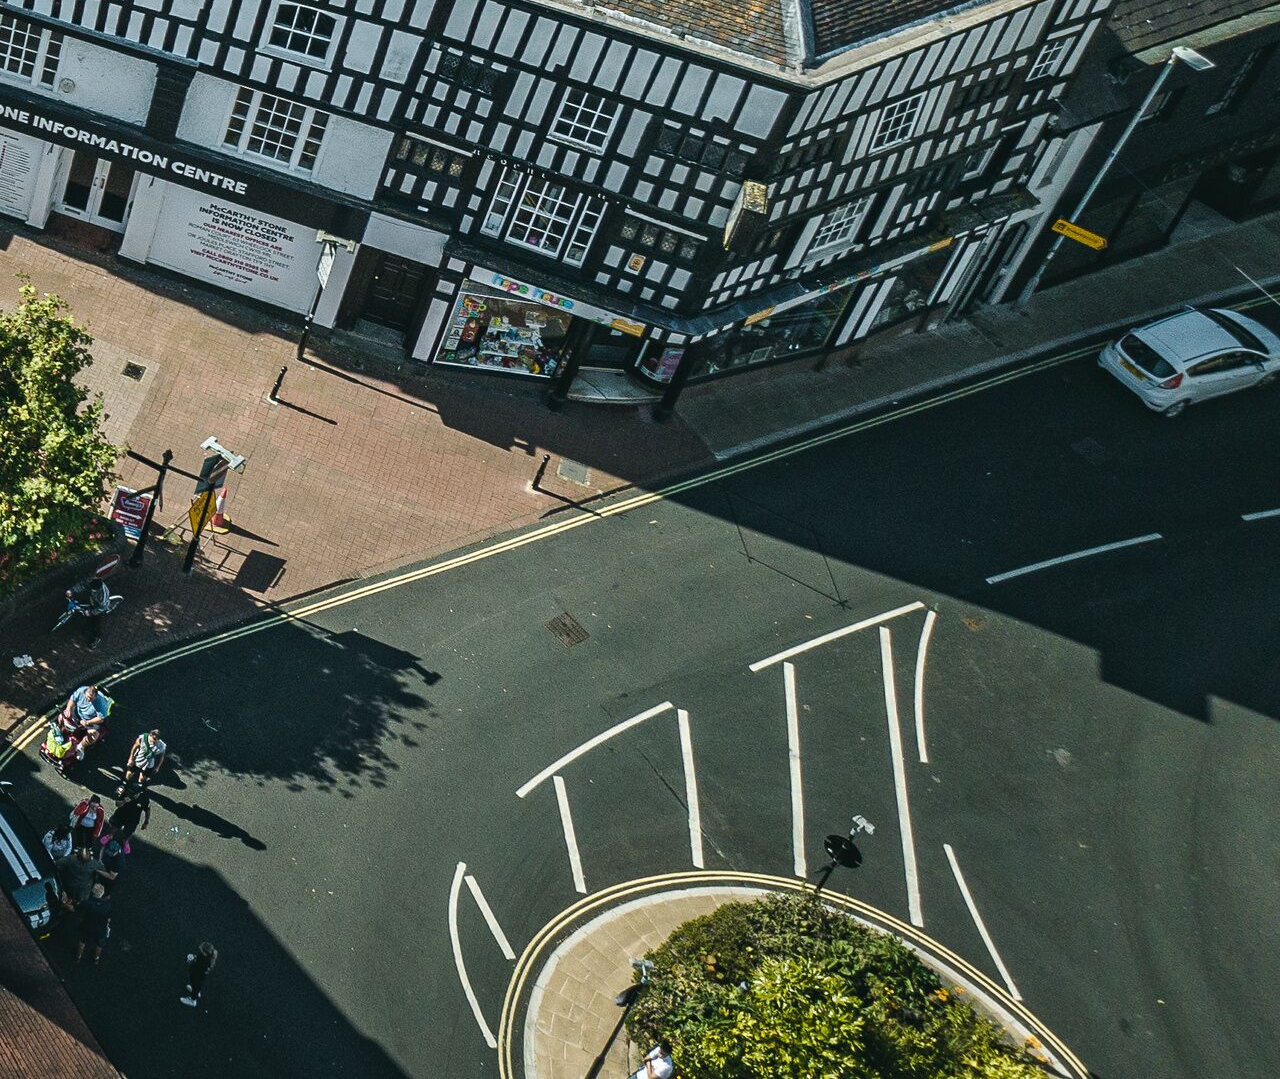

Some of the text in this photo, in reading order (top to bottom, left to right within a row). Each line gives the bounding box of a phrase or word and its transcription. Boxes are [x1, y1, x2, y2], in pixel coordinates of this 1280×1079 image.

[32, 115, 169, 169] INFORMATION
[171, 160, 247, 196] CENTRE
[198, 206, 294, 242] INFORMATION CENTRE
[209, 204, 288, 233] McCARTHY STONE
[221, 221, 244, 232] NOW
[244, 229, 278, 243] CLOSED
